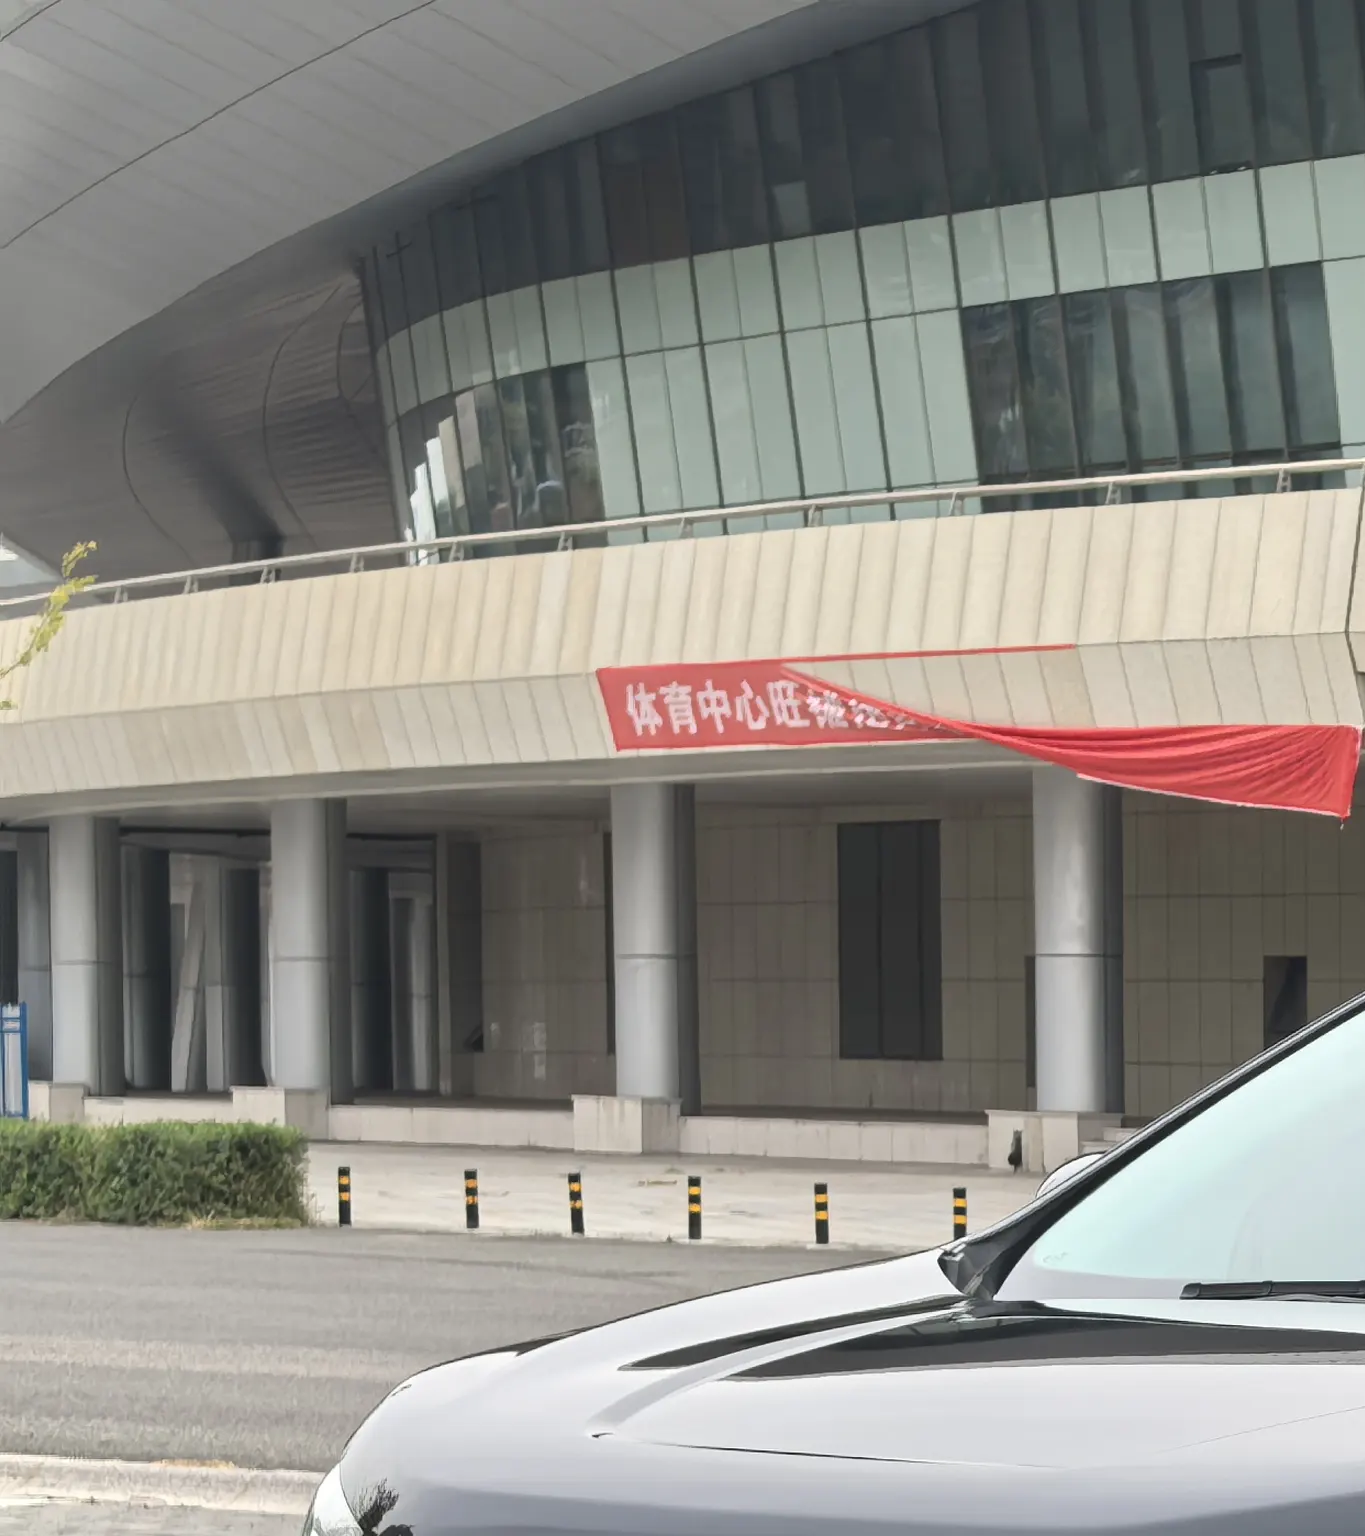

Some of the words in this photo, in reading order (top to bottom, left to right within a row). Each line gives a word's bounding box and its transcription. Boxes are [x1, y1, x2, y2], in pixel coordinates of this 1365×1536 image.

[625, 679, 892, 737] 体育中心旺
